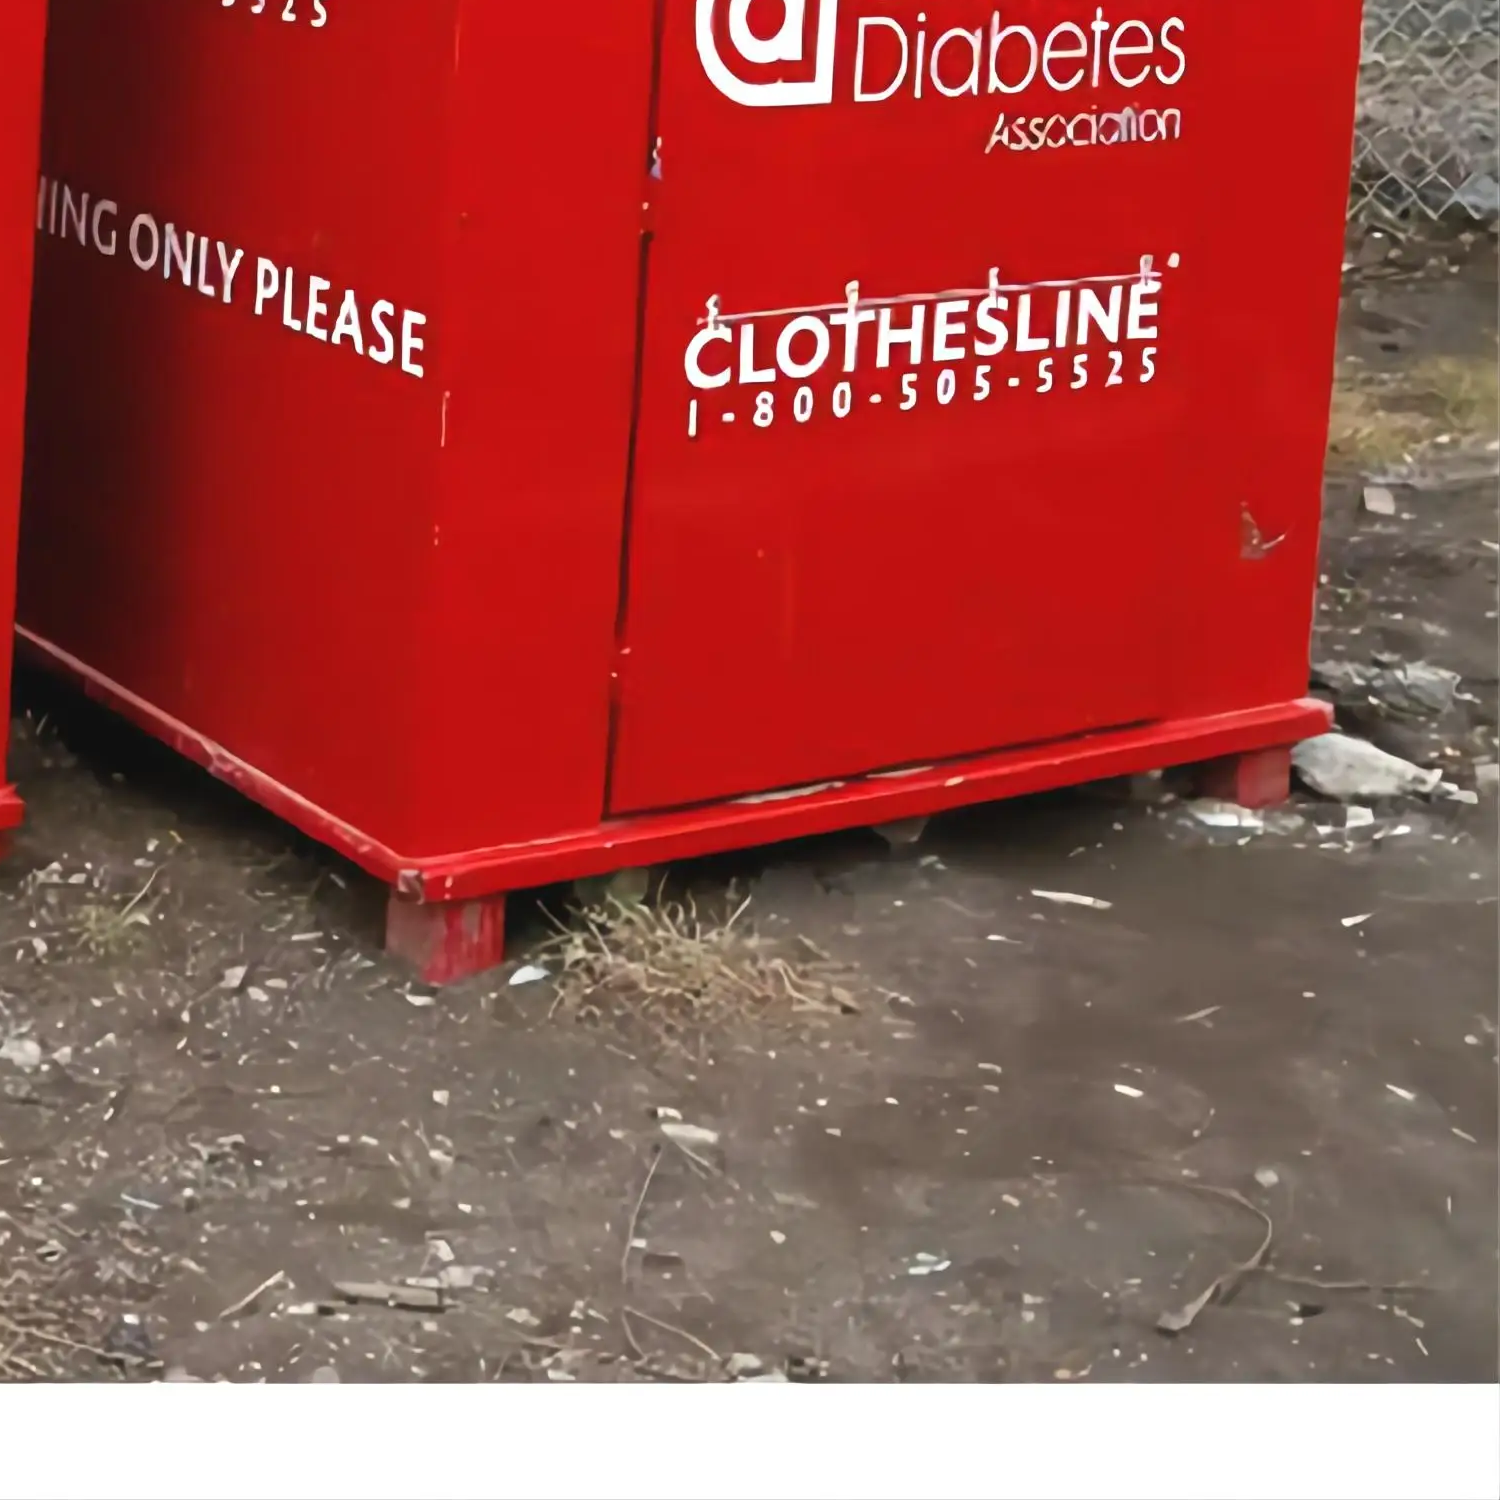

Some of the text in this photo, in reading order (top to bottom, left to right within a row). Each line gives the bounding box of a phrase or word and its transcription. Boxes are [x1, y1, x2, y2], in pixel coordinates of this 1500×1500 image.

[854, 7, 1186, 102] Diabetes
[984, 102, 1180, 154] Association
[129, 213, 243, 303] ONLY
[254, 257, 426, 377] PLEASE
[684, 275, 1161, 388] CLOTHESLINE
